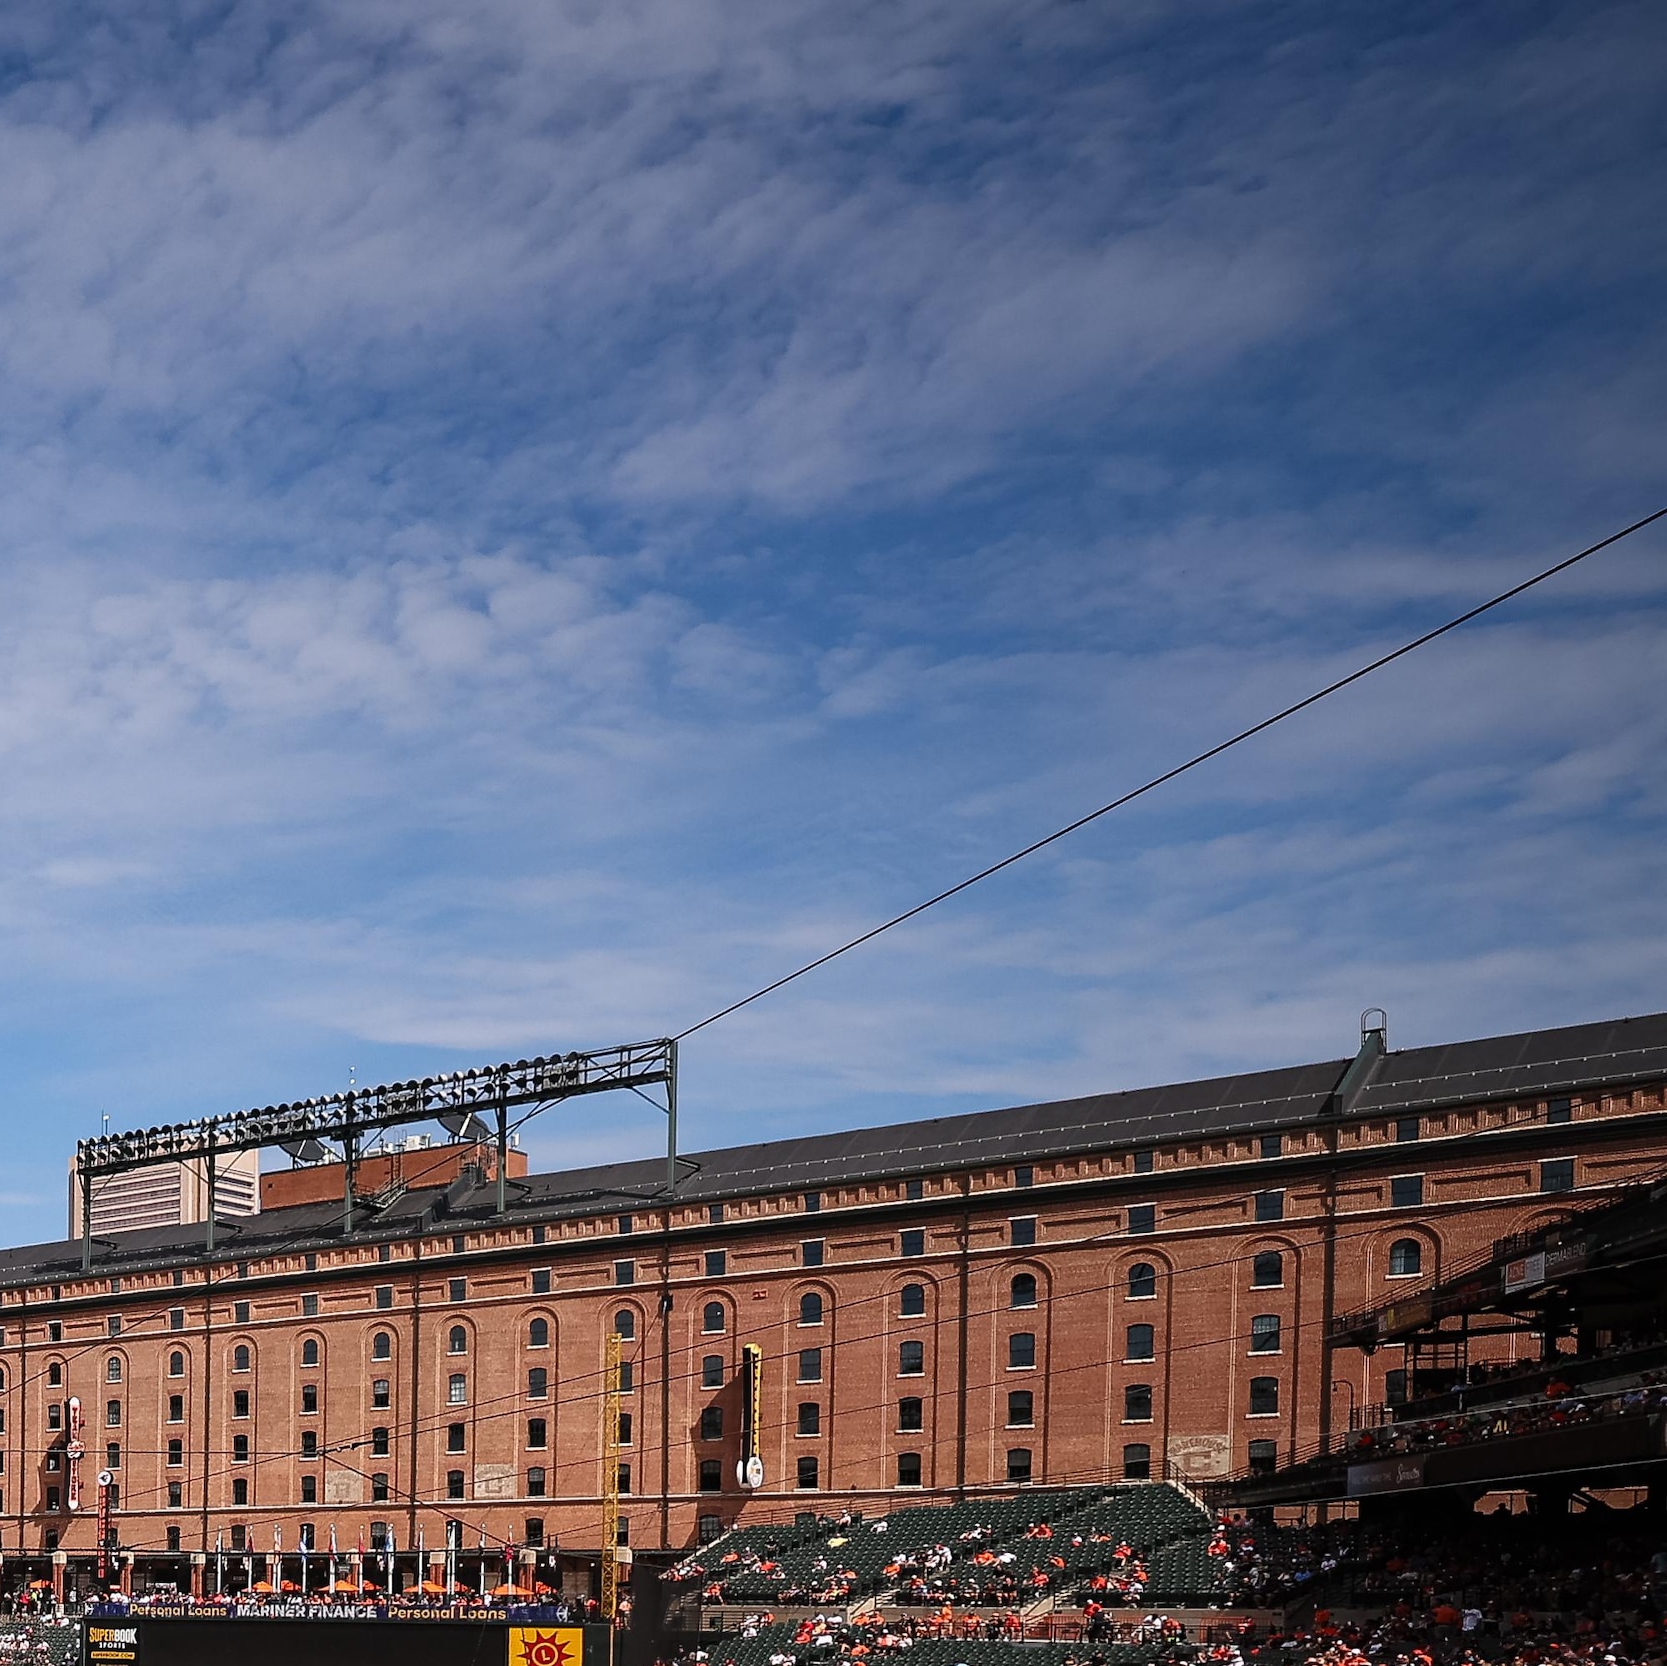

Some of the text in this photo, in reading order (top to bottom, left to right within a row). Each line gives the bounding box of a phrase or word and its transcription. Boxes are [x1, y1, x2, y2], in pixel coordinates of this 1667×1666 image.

[130, 1605, 227, 1617] Personal Loans
[237, 1605, 377, 1618] MARINER FINANCE
[388, 1606, 506, 1620] Personal Loans
[89, 1627, 137, 1644] SUPERBOOK
